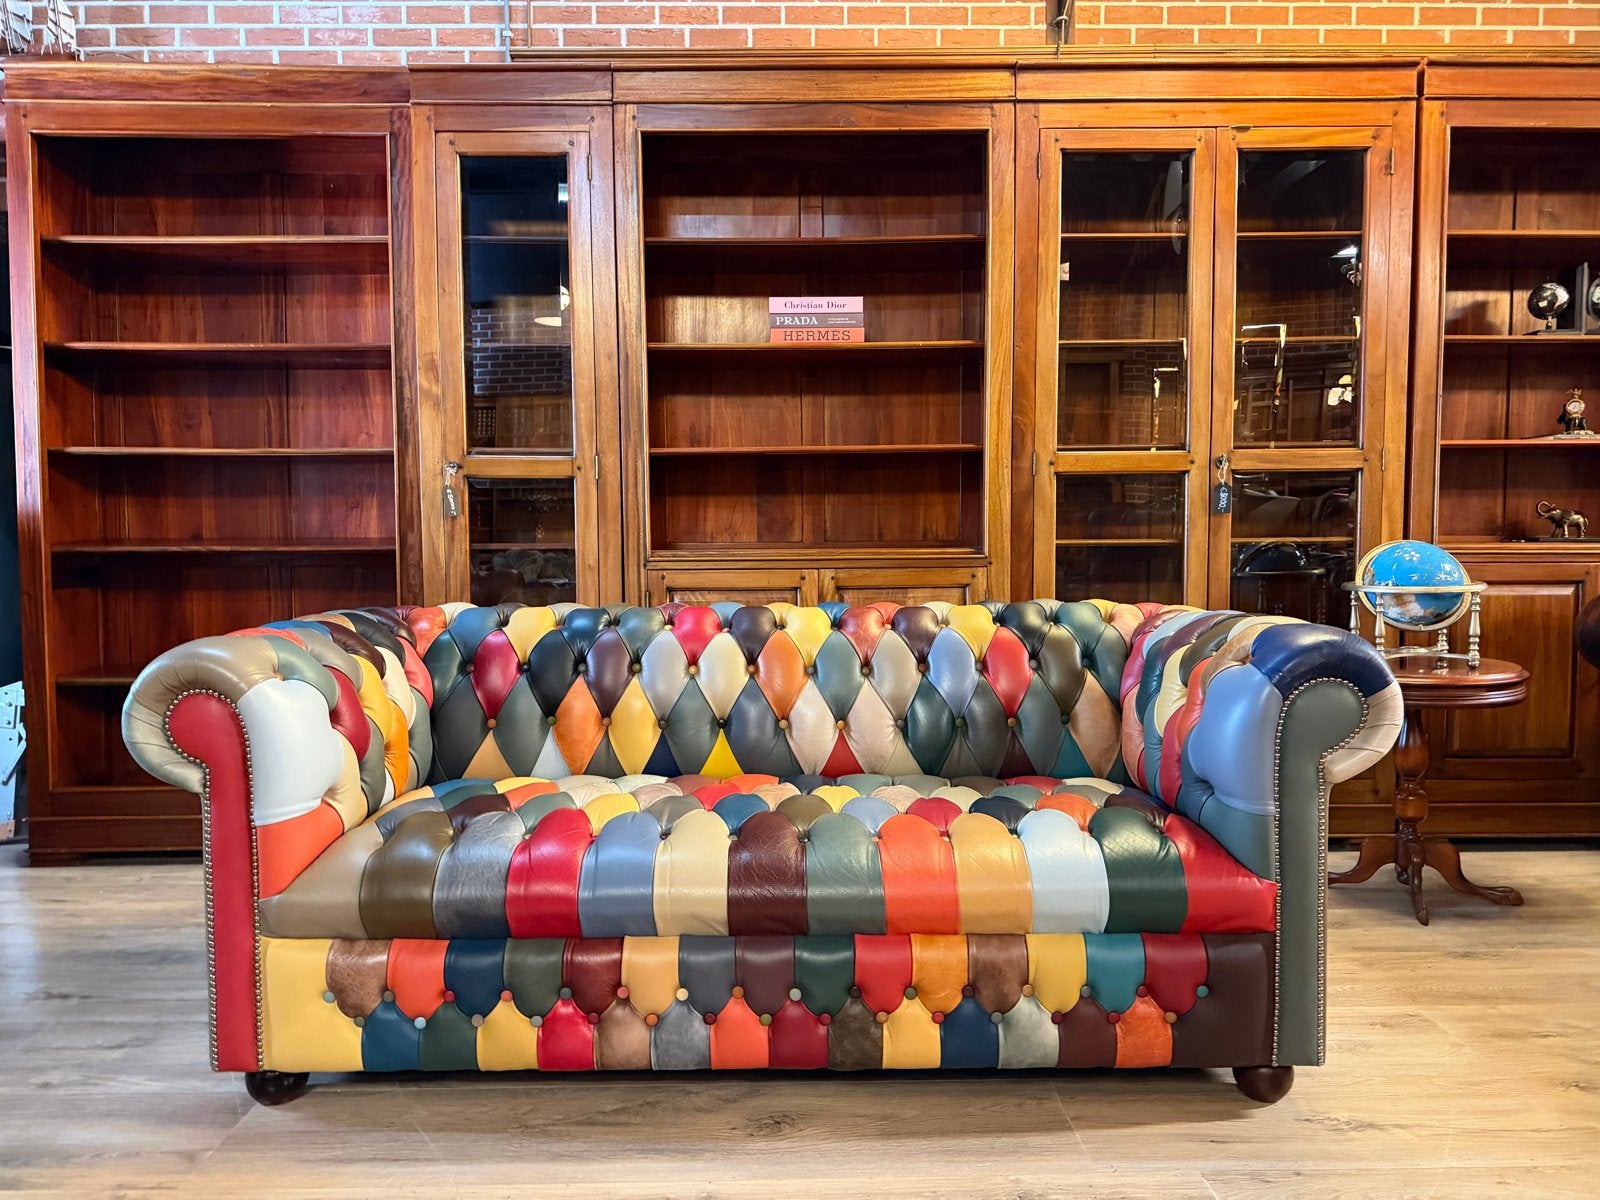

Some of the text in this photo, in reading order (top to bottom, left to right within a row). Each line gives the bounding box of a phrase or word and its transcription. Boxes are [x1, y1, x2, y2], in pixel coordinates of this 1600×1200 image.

[784, 301, 847, 309] Christian Dior
[775, 316, 818, 325] PRADA
